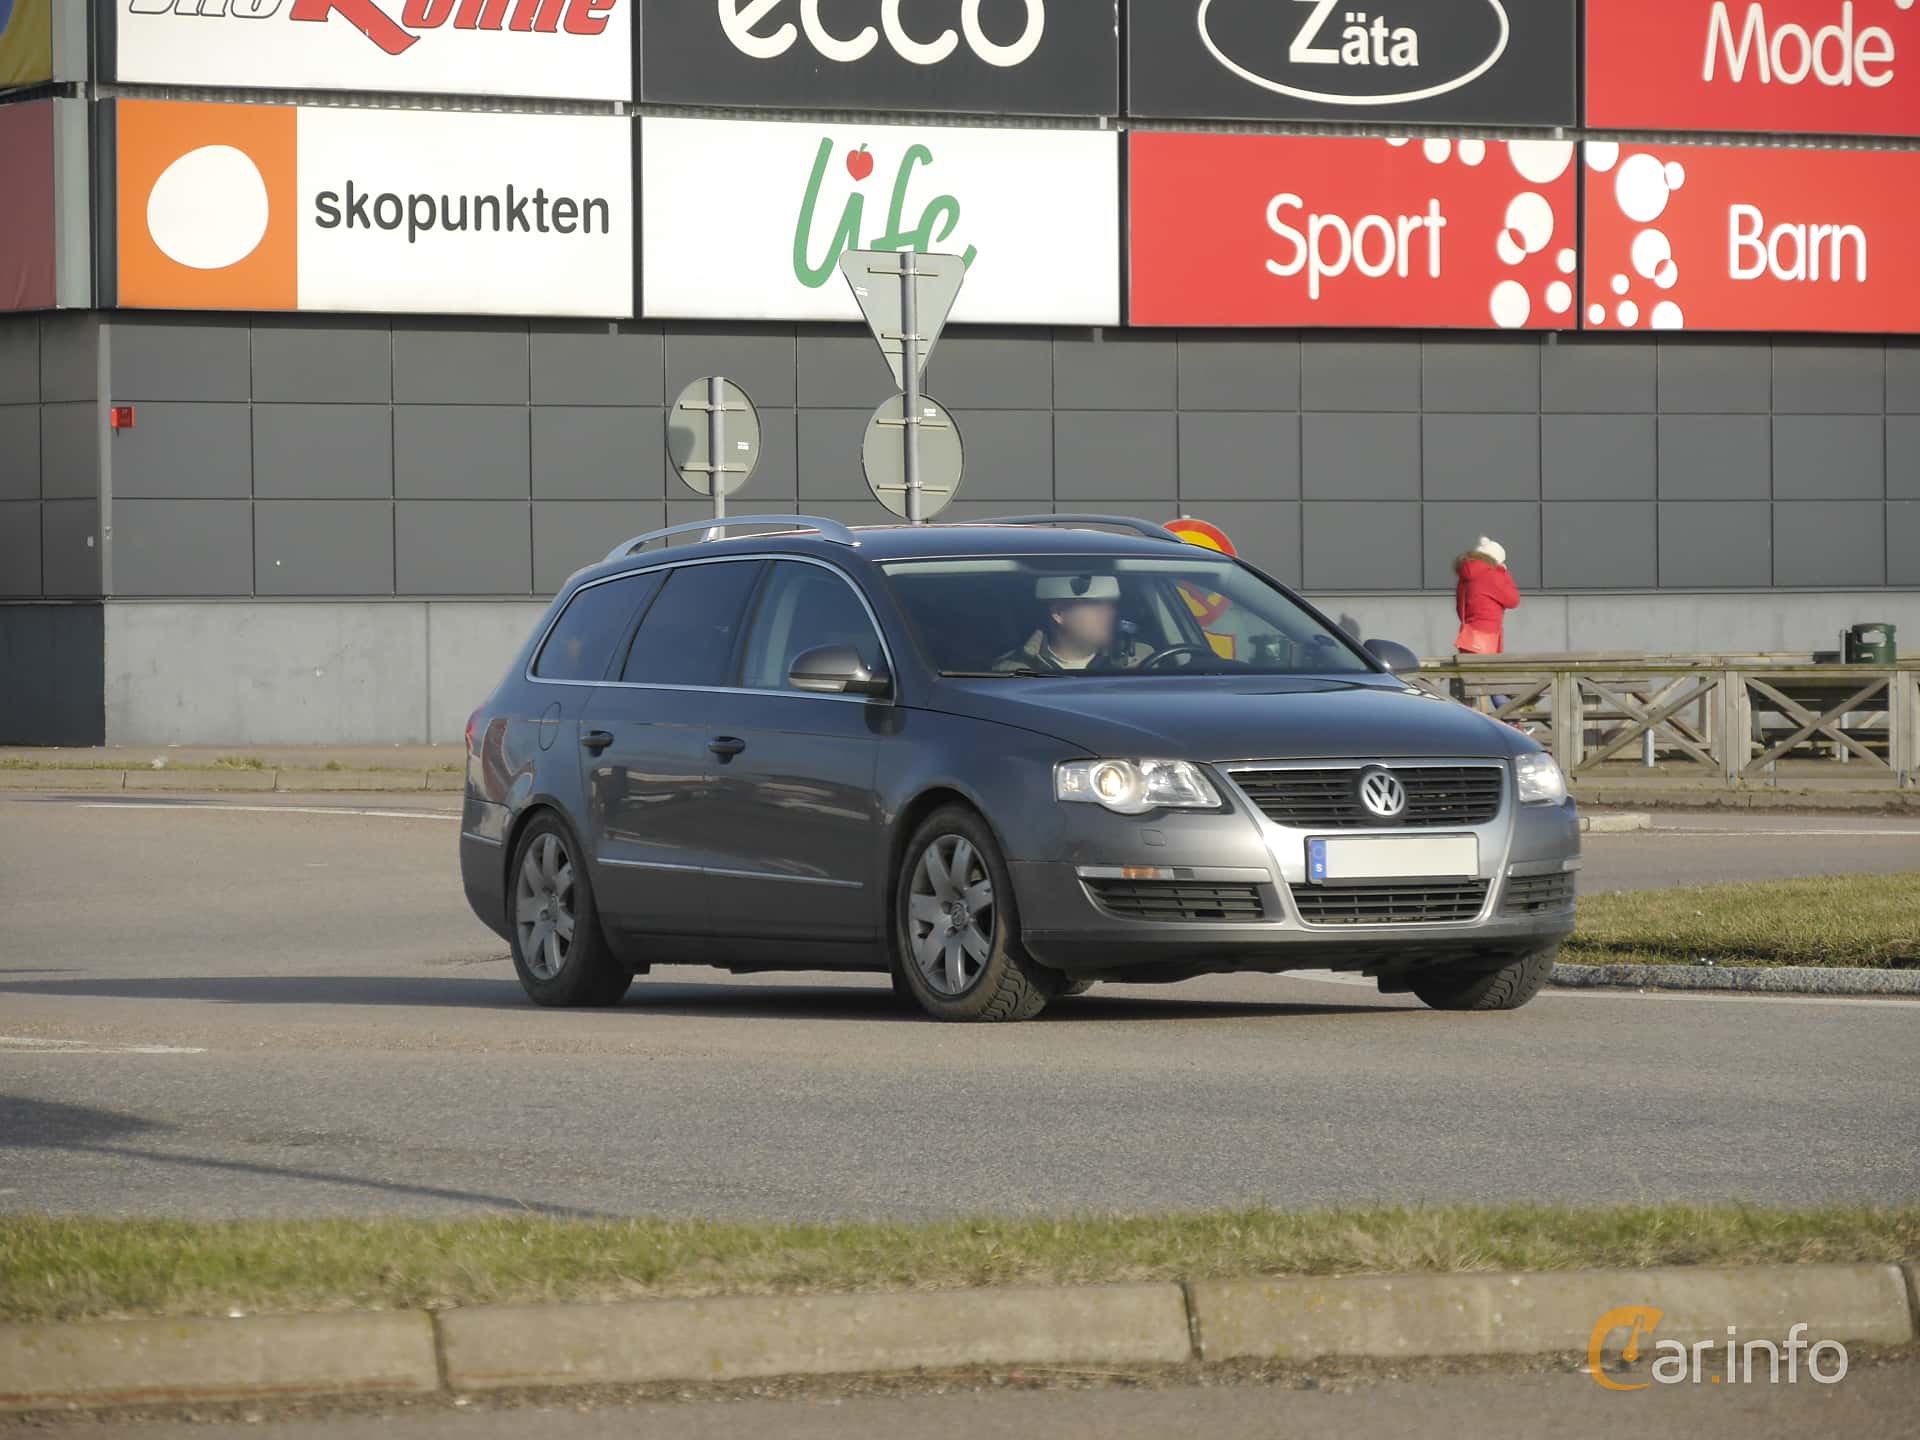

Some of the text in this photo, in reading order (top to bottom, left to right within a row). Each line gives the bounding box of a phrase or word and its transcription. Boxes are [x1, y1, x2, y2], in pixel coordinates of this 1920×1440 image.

[718, 0, 1045, 67] ecco
[1289, 0, 1420, 66] Zäta
[1703, 1, 1895, 87] Mode
[314, 180, 609, 243] skopunkten
[1265, 193, 1447, 300] Sport
[1728, 203, 1867, 282] Barn
